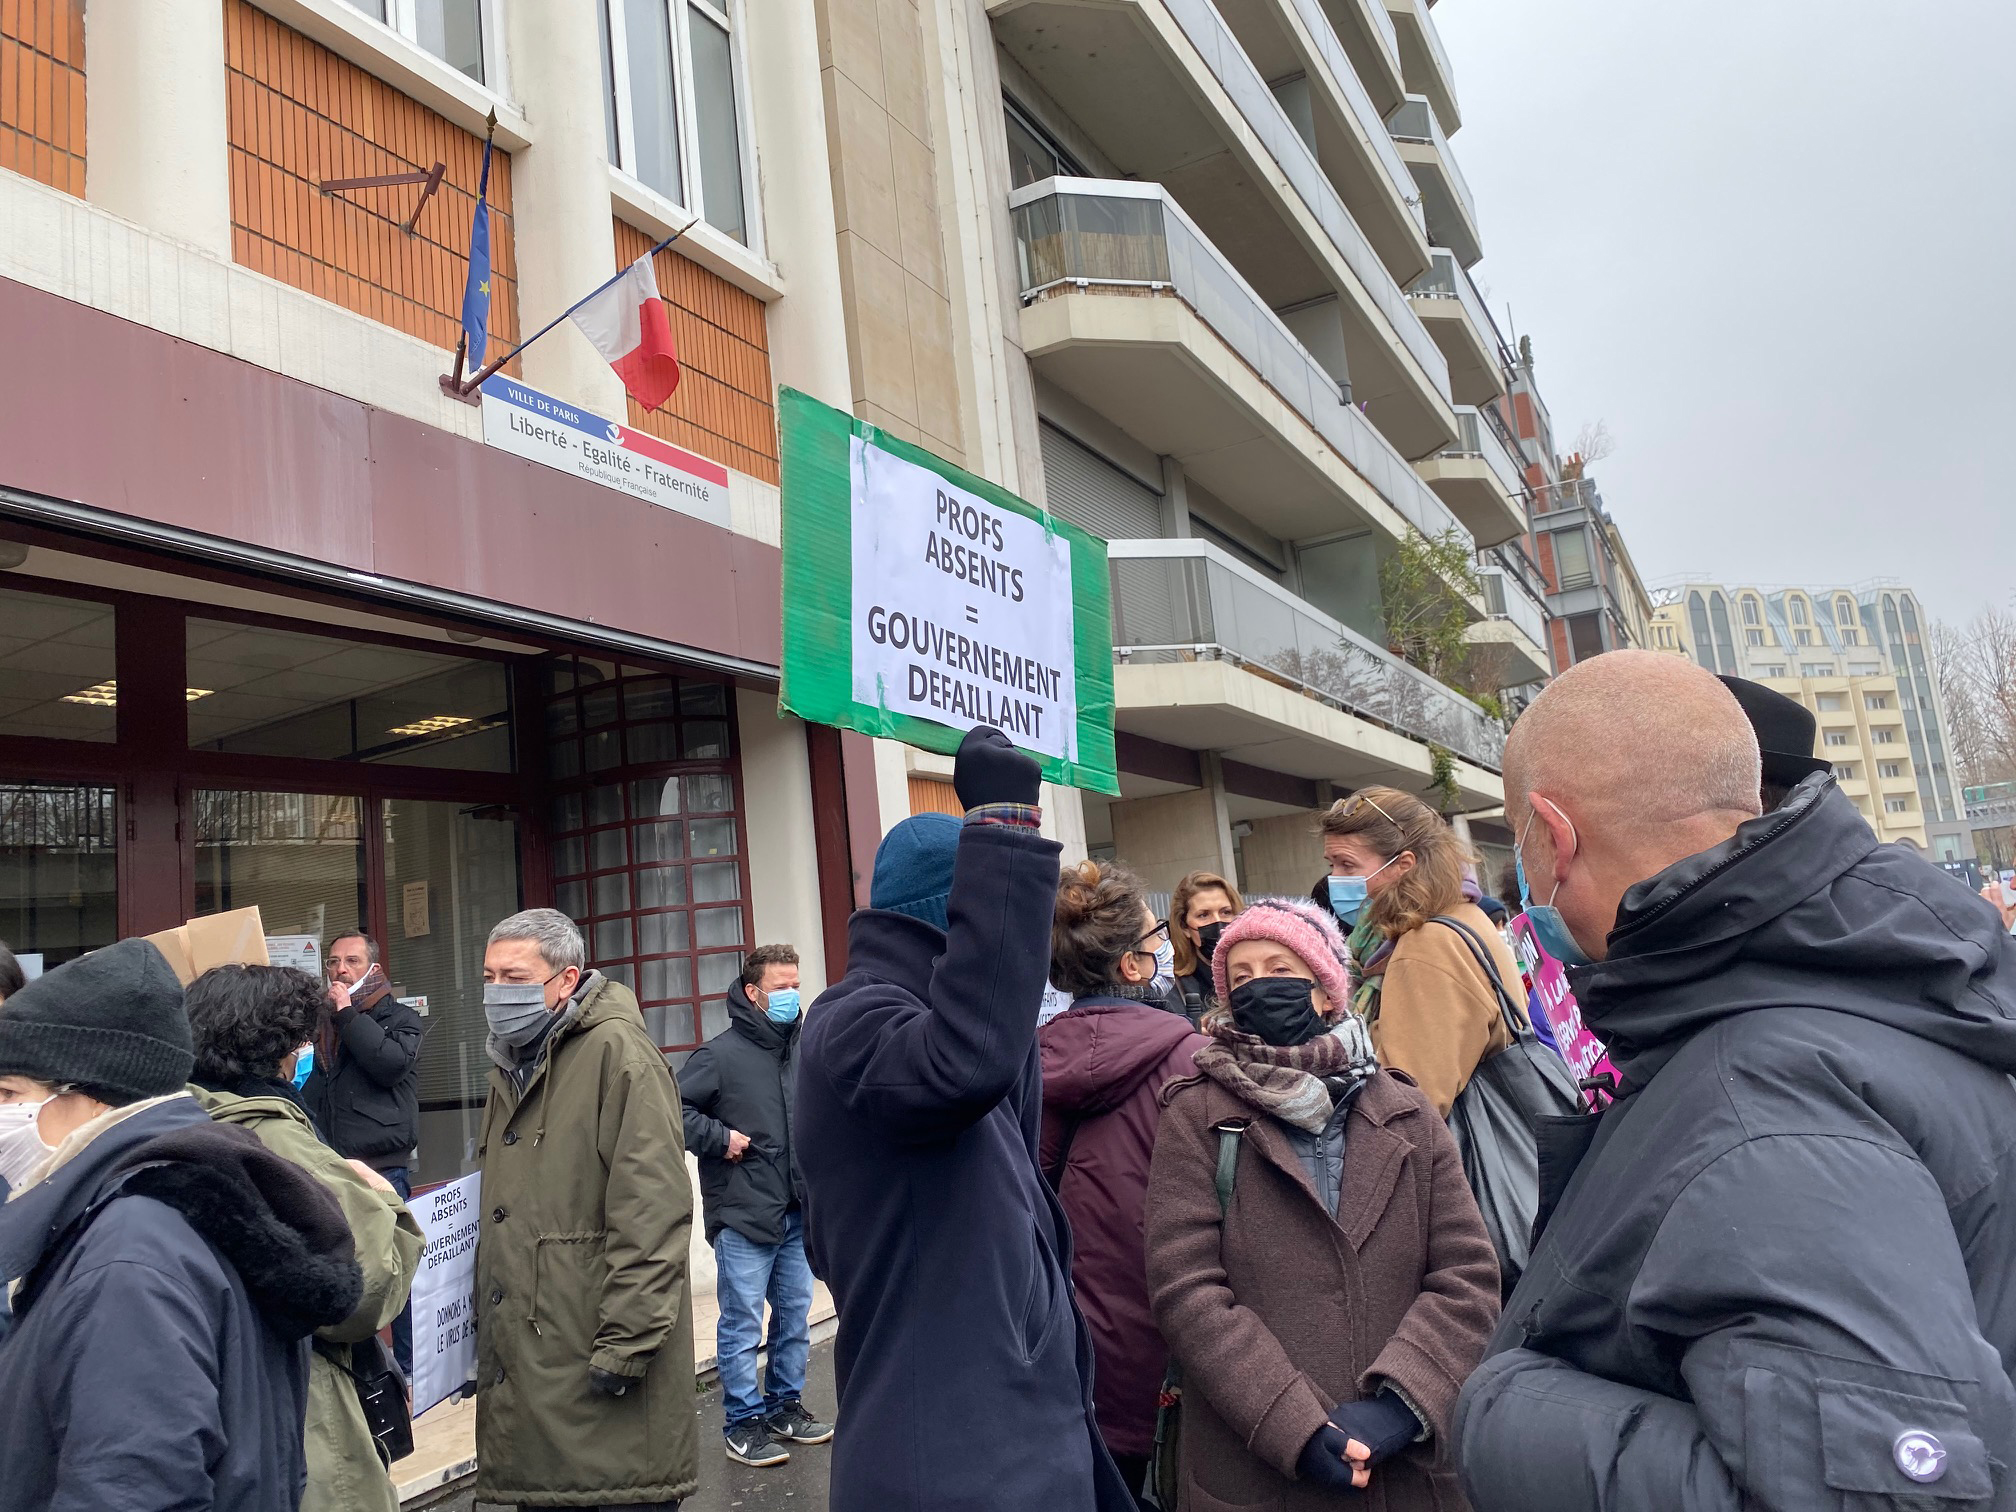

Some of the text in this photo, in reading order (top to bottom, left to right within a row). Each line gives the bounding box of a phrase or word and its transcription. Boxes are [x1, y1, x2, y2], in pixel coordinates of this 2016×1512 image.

[507, 387, 580, 425] VILLE DE PARIS
[510, 412, 567, 449] Liberté
[582, 440, 631, 473] Egalité
[644, 464, 709, 502] Fraternité
[578, 461, 657, 498] République Française
[936, 488, 1004, 552] PROFS
[925, 530, 1024, 602] ABSENTS
[965, 604, 979, 624] =
[868, 605, 1061, 702] GOUVERNEMENT
[908, 663, 1043, 739] DEFAILLANT
[431, 1198, 468, 1224] ABSENTS
[434, 1186, 461, 1208] PROFS
[422, 1219, 480, 1257] OUVERNEMENT
[428, 1236, 475, 1269] DEFAILLANT
[437, 1333, 443, 1354] LE
[446, 1325, 460, 1348] VIRUS
